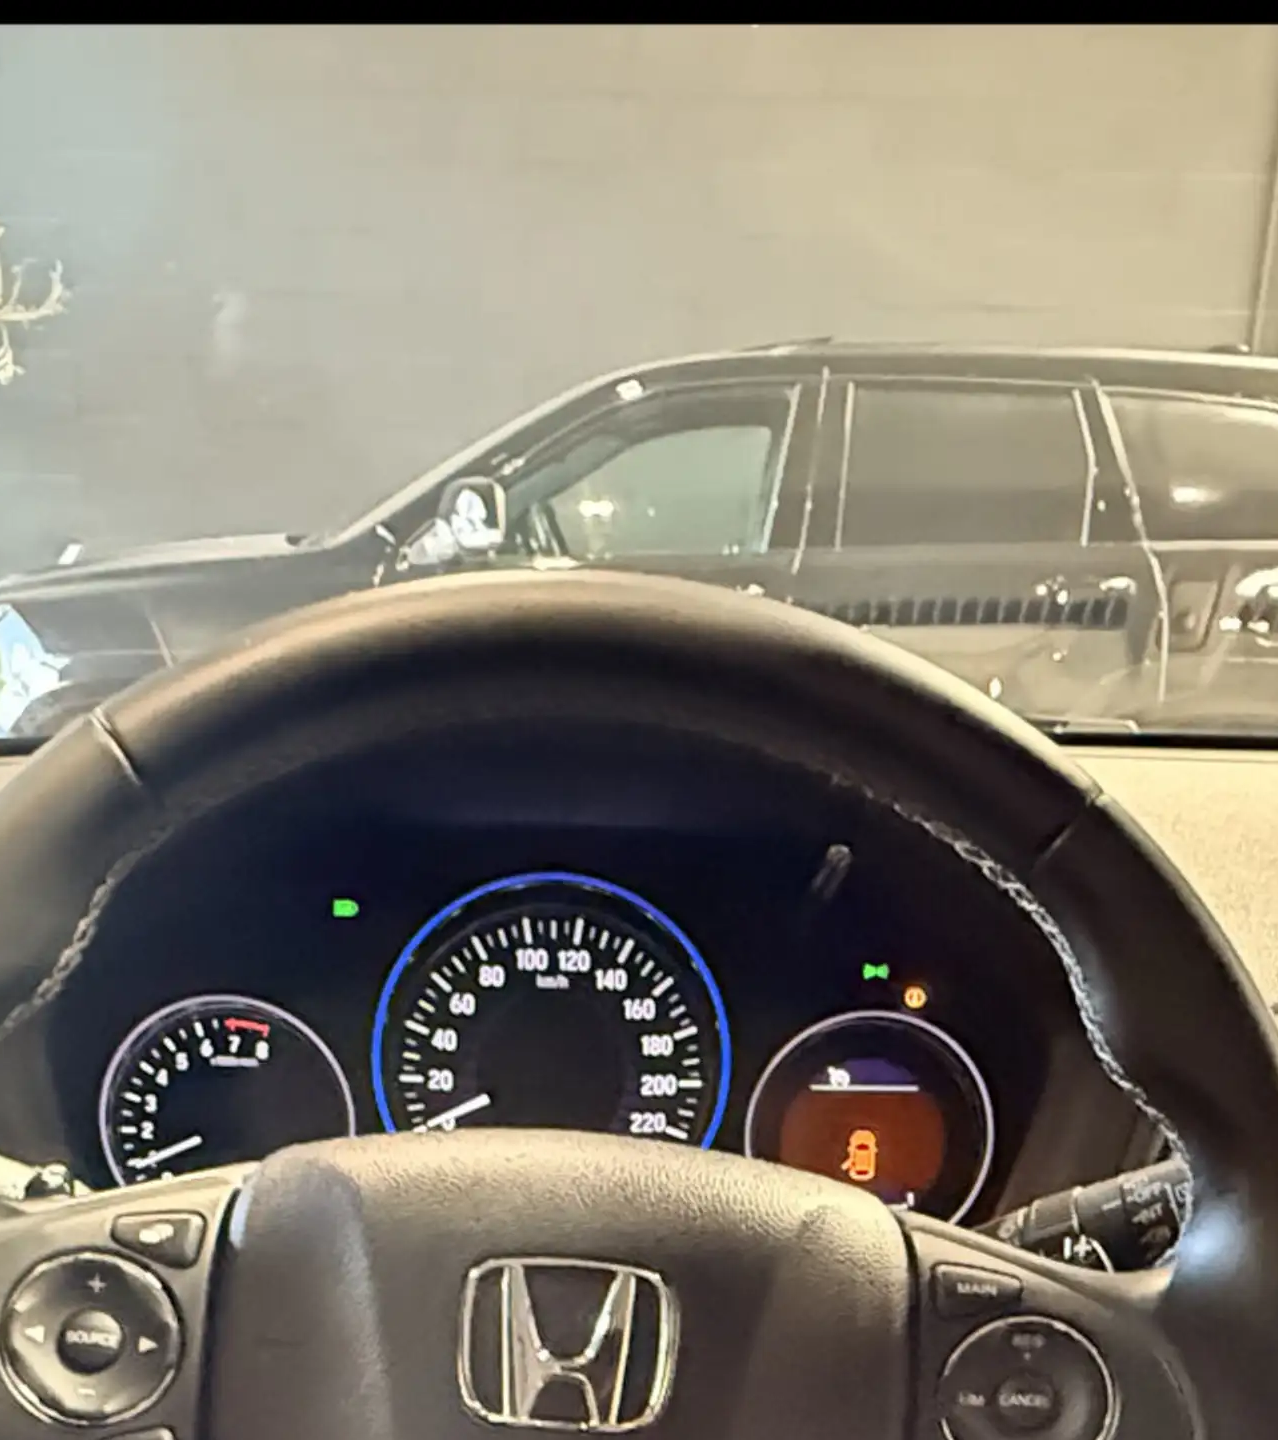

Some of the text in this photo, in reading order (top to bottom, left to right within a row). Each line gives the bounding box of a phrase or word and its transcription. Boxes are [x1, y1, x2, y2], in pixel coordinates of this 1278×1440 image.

[515, 948, 549, 971] 100
[558, 950, 592, 973] 120
[478, 965, 505, 987] 80
[594, 968, 629, 991] 140
[448, 993, 476, 1016] 60
[622, 998, 657, 1021] 160
[198, 1037, 215, 1058] 6
[226, 1034, 242, 1054] 7
[430, 1028, 459, 1051] 40
[639, 1034, 674, 1057] 180
[174, 1051, 190, 1071] 5
[154, 1067, 170, 1088] 4
[426, 1069, 455, 1092] 20
[639, 1074, 678, 1096] 200
[143, 1094, 158, 1114] 3
[139, 1120, 155, 1140] 2
[629, 1112, 667, 1134] 220
[956, 1281, 998, 1298] MAIN
